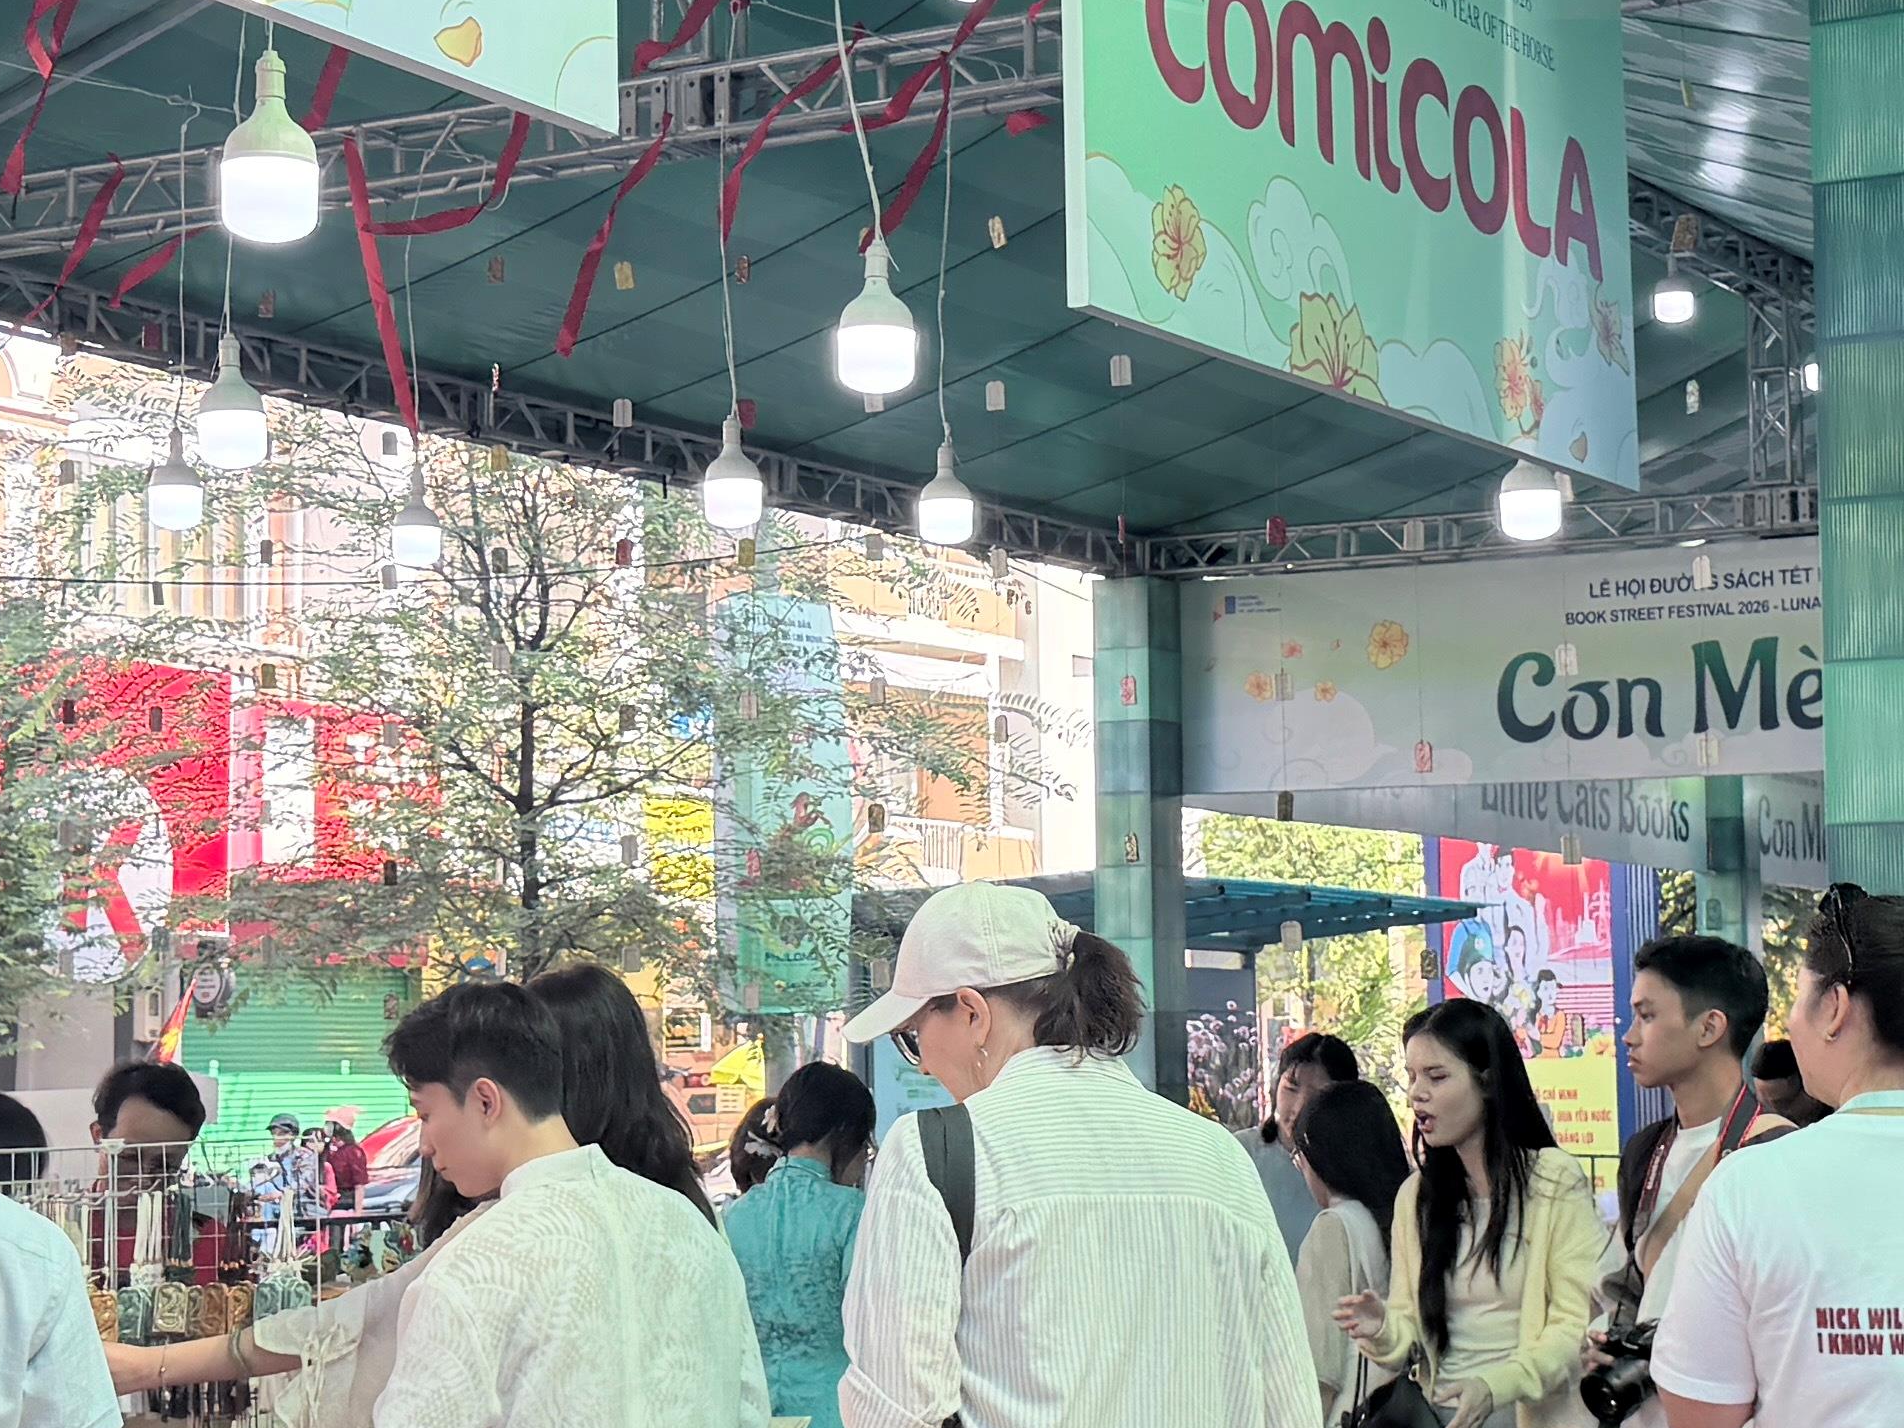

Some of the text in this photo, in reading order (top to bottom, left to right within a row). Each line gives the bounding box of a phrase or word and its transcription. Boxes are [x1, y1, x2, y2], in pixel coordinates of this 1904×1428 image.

[1483, 11, 1499, 39] OF
[1499, 18, 1520, 53] THE
[1522, 32, 1556, 72] HORSE
[1616, 577, 1646, 599] HỘI
[1649, 572, 1719, 594] ĐƯỜG
[1723, 567, 1774, 590] SÁCH
[1565, 609, 1607, 625] BOOK
[1609, 605, 1664, 622] STREET
[1668, 601, 1735, 620] FESTIVAL
[1737, 599, 1770, 615] 2026
[1781, 595, 1822, 613] LUNA
[1691, 635, 1823, 733] Mè
[1815, 1307, 1861, 1330] NICK
[1817, 1332, 1824, 1354] I
[1828, 1333, 1884, 1356] KNOW
